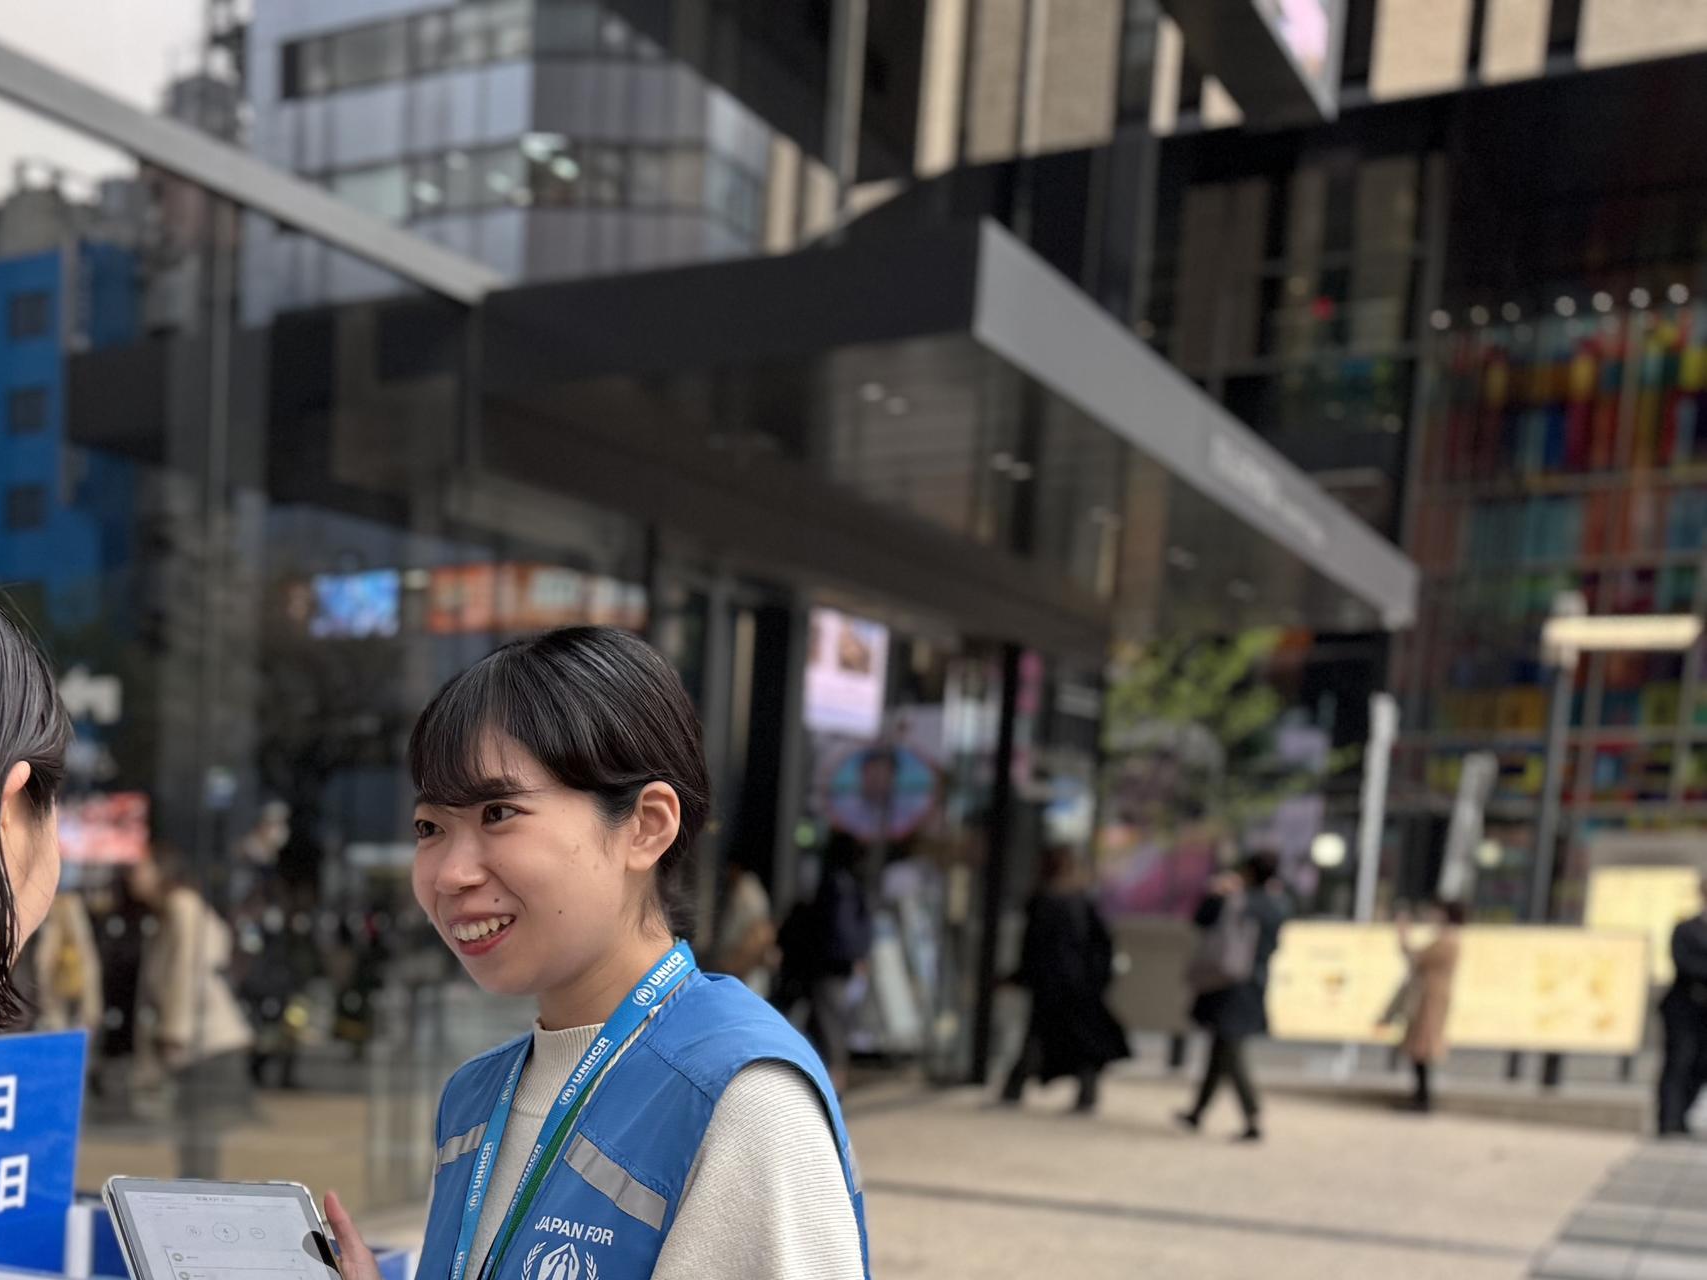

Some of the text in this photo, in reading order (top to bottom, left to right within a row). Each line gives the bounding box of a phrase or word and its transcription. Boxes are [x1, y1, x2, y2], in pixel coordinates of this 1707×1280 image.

[572, 1036, 610, 1084] UNHCR
[473, 1141, 493, 1190] UNHCR
[534, 1216, 614, 1246] JAPAN FOR
